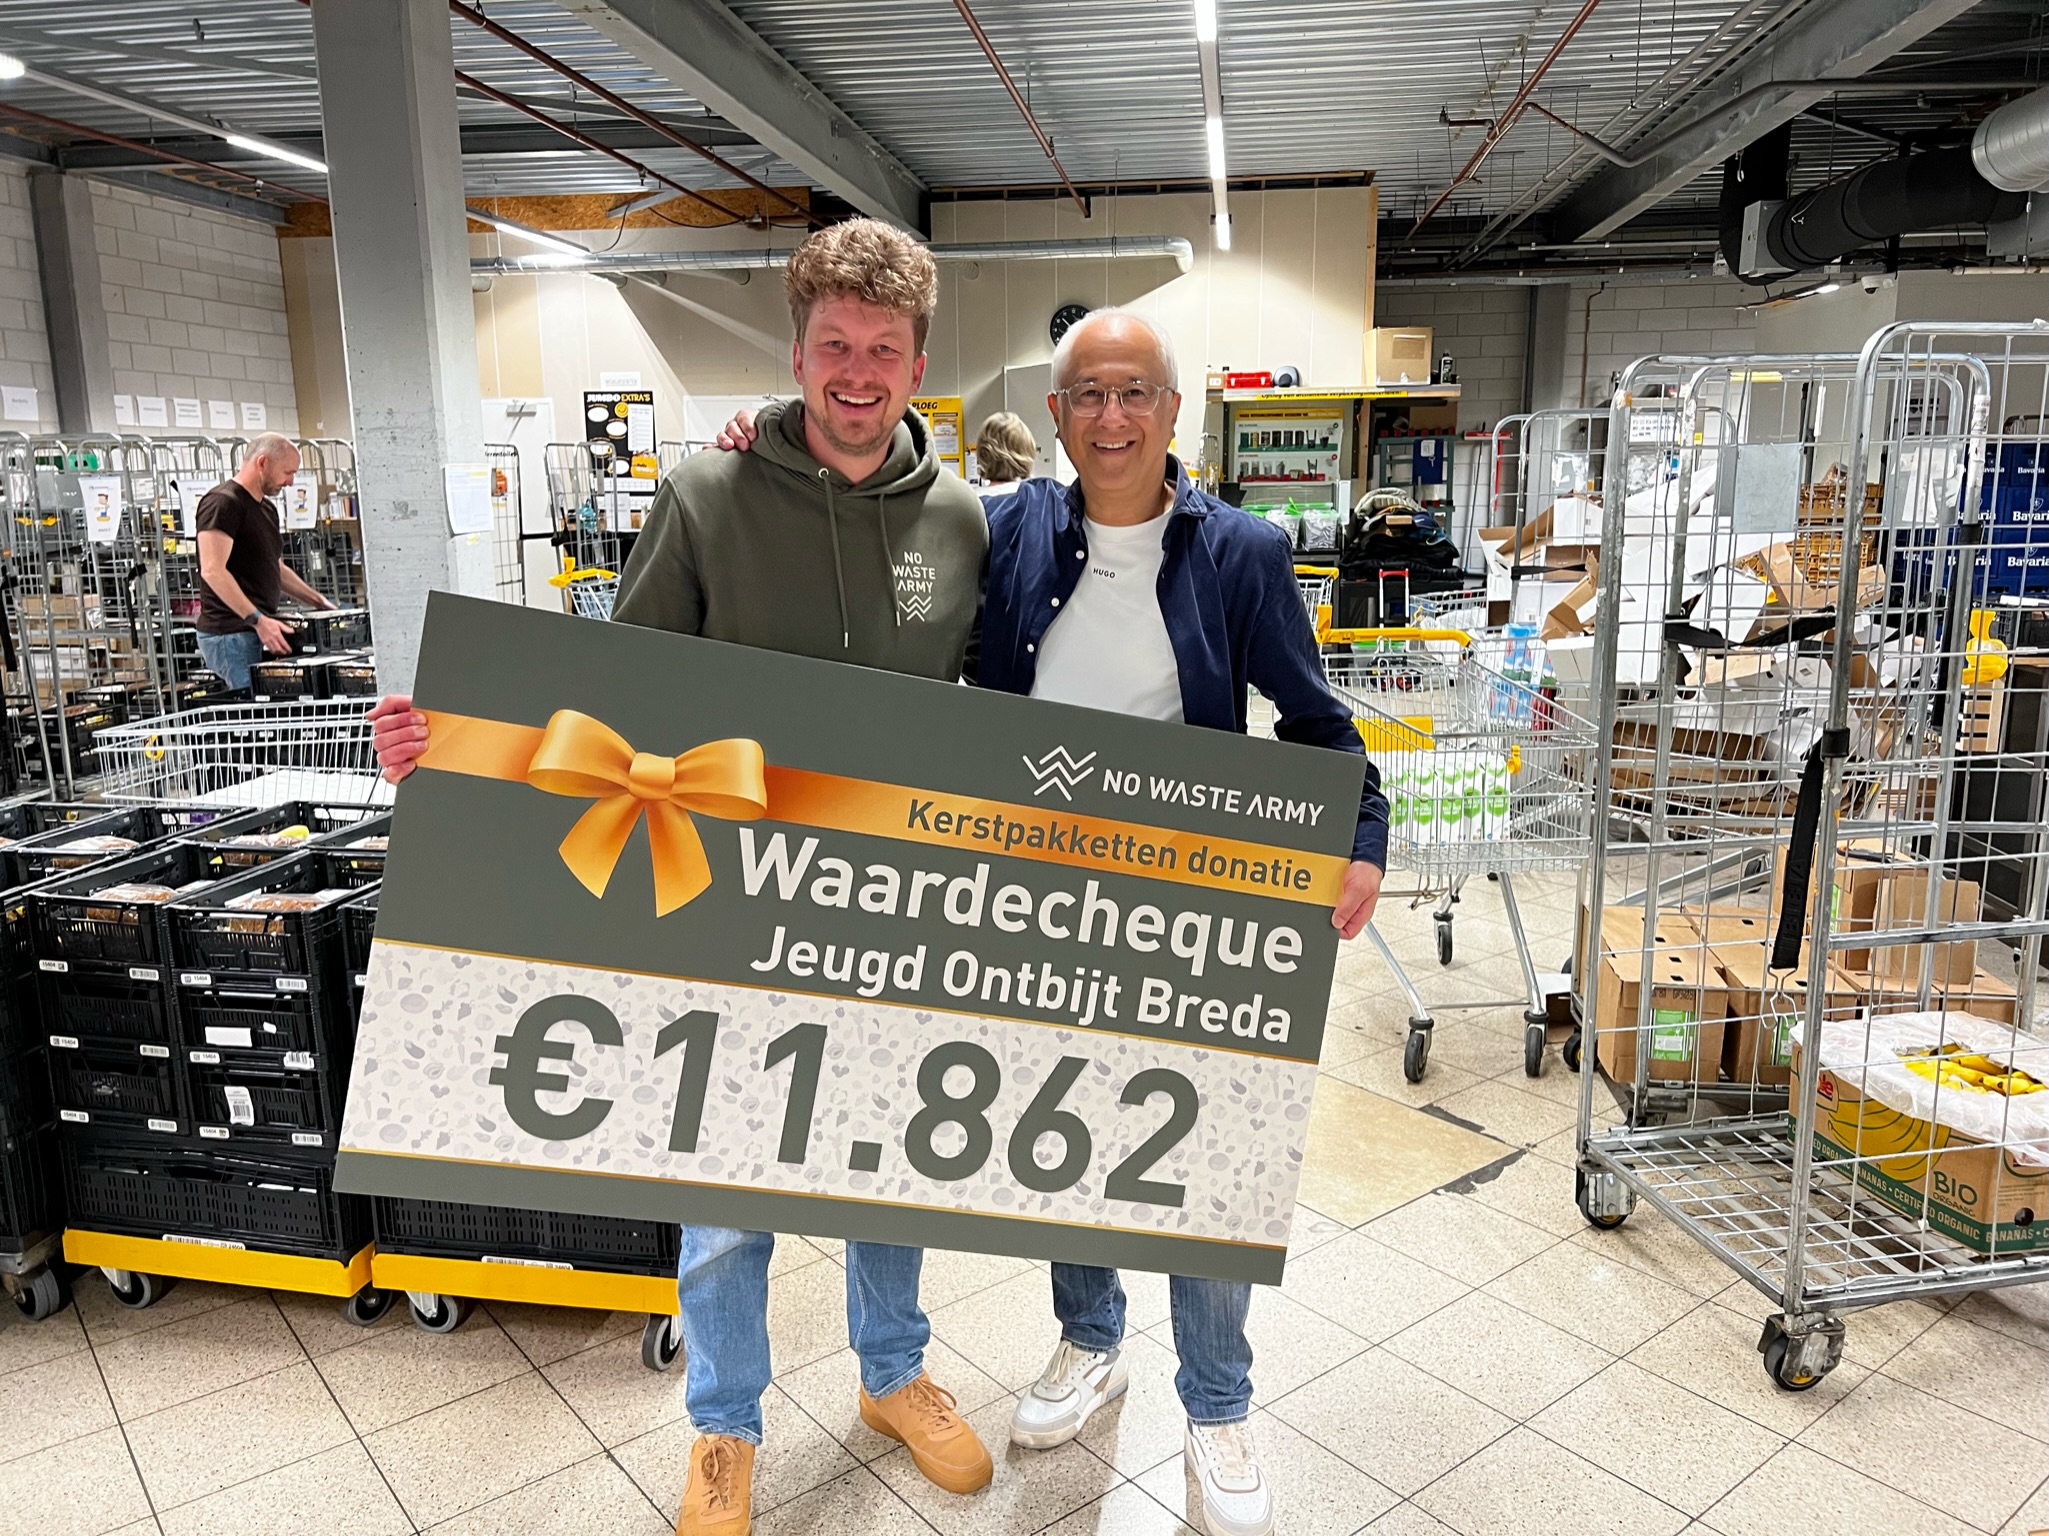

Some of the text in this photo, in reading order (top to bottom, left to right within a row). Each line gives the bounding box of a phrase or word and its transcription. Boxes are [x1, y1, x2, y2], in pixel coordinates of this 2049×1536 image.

[587, 394, 650, 402] JUMBO EXTRA'S
[911, 401, 938, 410] PLOEG
[2017, 466, 2045, 474] Bavaia
[2012, 510, 2049, 521] Bavari
[904, 551, 922, 564] NO
[892, 565, 936, 580] WASTE
[1093, 568, 1115, 578] HUGO
[897, 579, 933, 593] ARMY
[1103, 768, 1325, 827] NO WASTE ARMY
[906, 798, 1313, 891] Kerstpakketten donatie
[738, 826, 1303, 977] Waardecheque
[750, 926, 1292, 1044] Jeugd Ontbijt Breda
[489, 993, 1200, 1208] €11.862
[1933, 1170, 1978, 1206] BIO
[1853, 1164, 1887, 1191] ANANAS
[1894, 1188, 1936, 1219] CERTIFED
[1937, 1211, 1980, 1241] ORGANIC
[1932, 1192, 1976, 1218] ORGANIC
[1985, 1228, 2034, 1243] BANANAS
